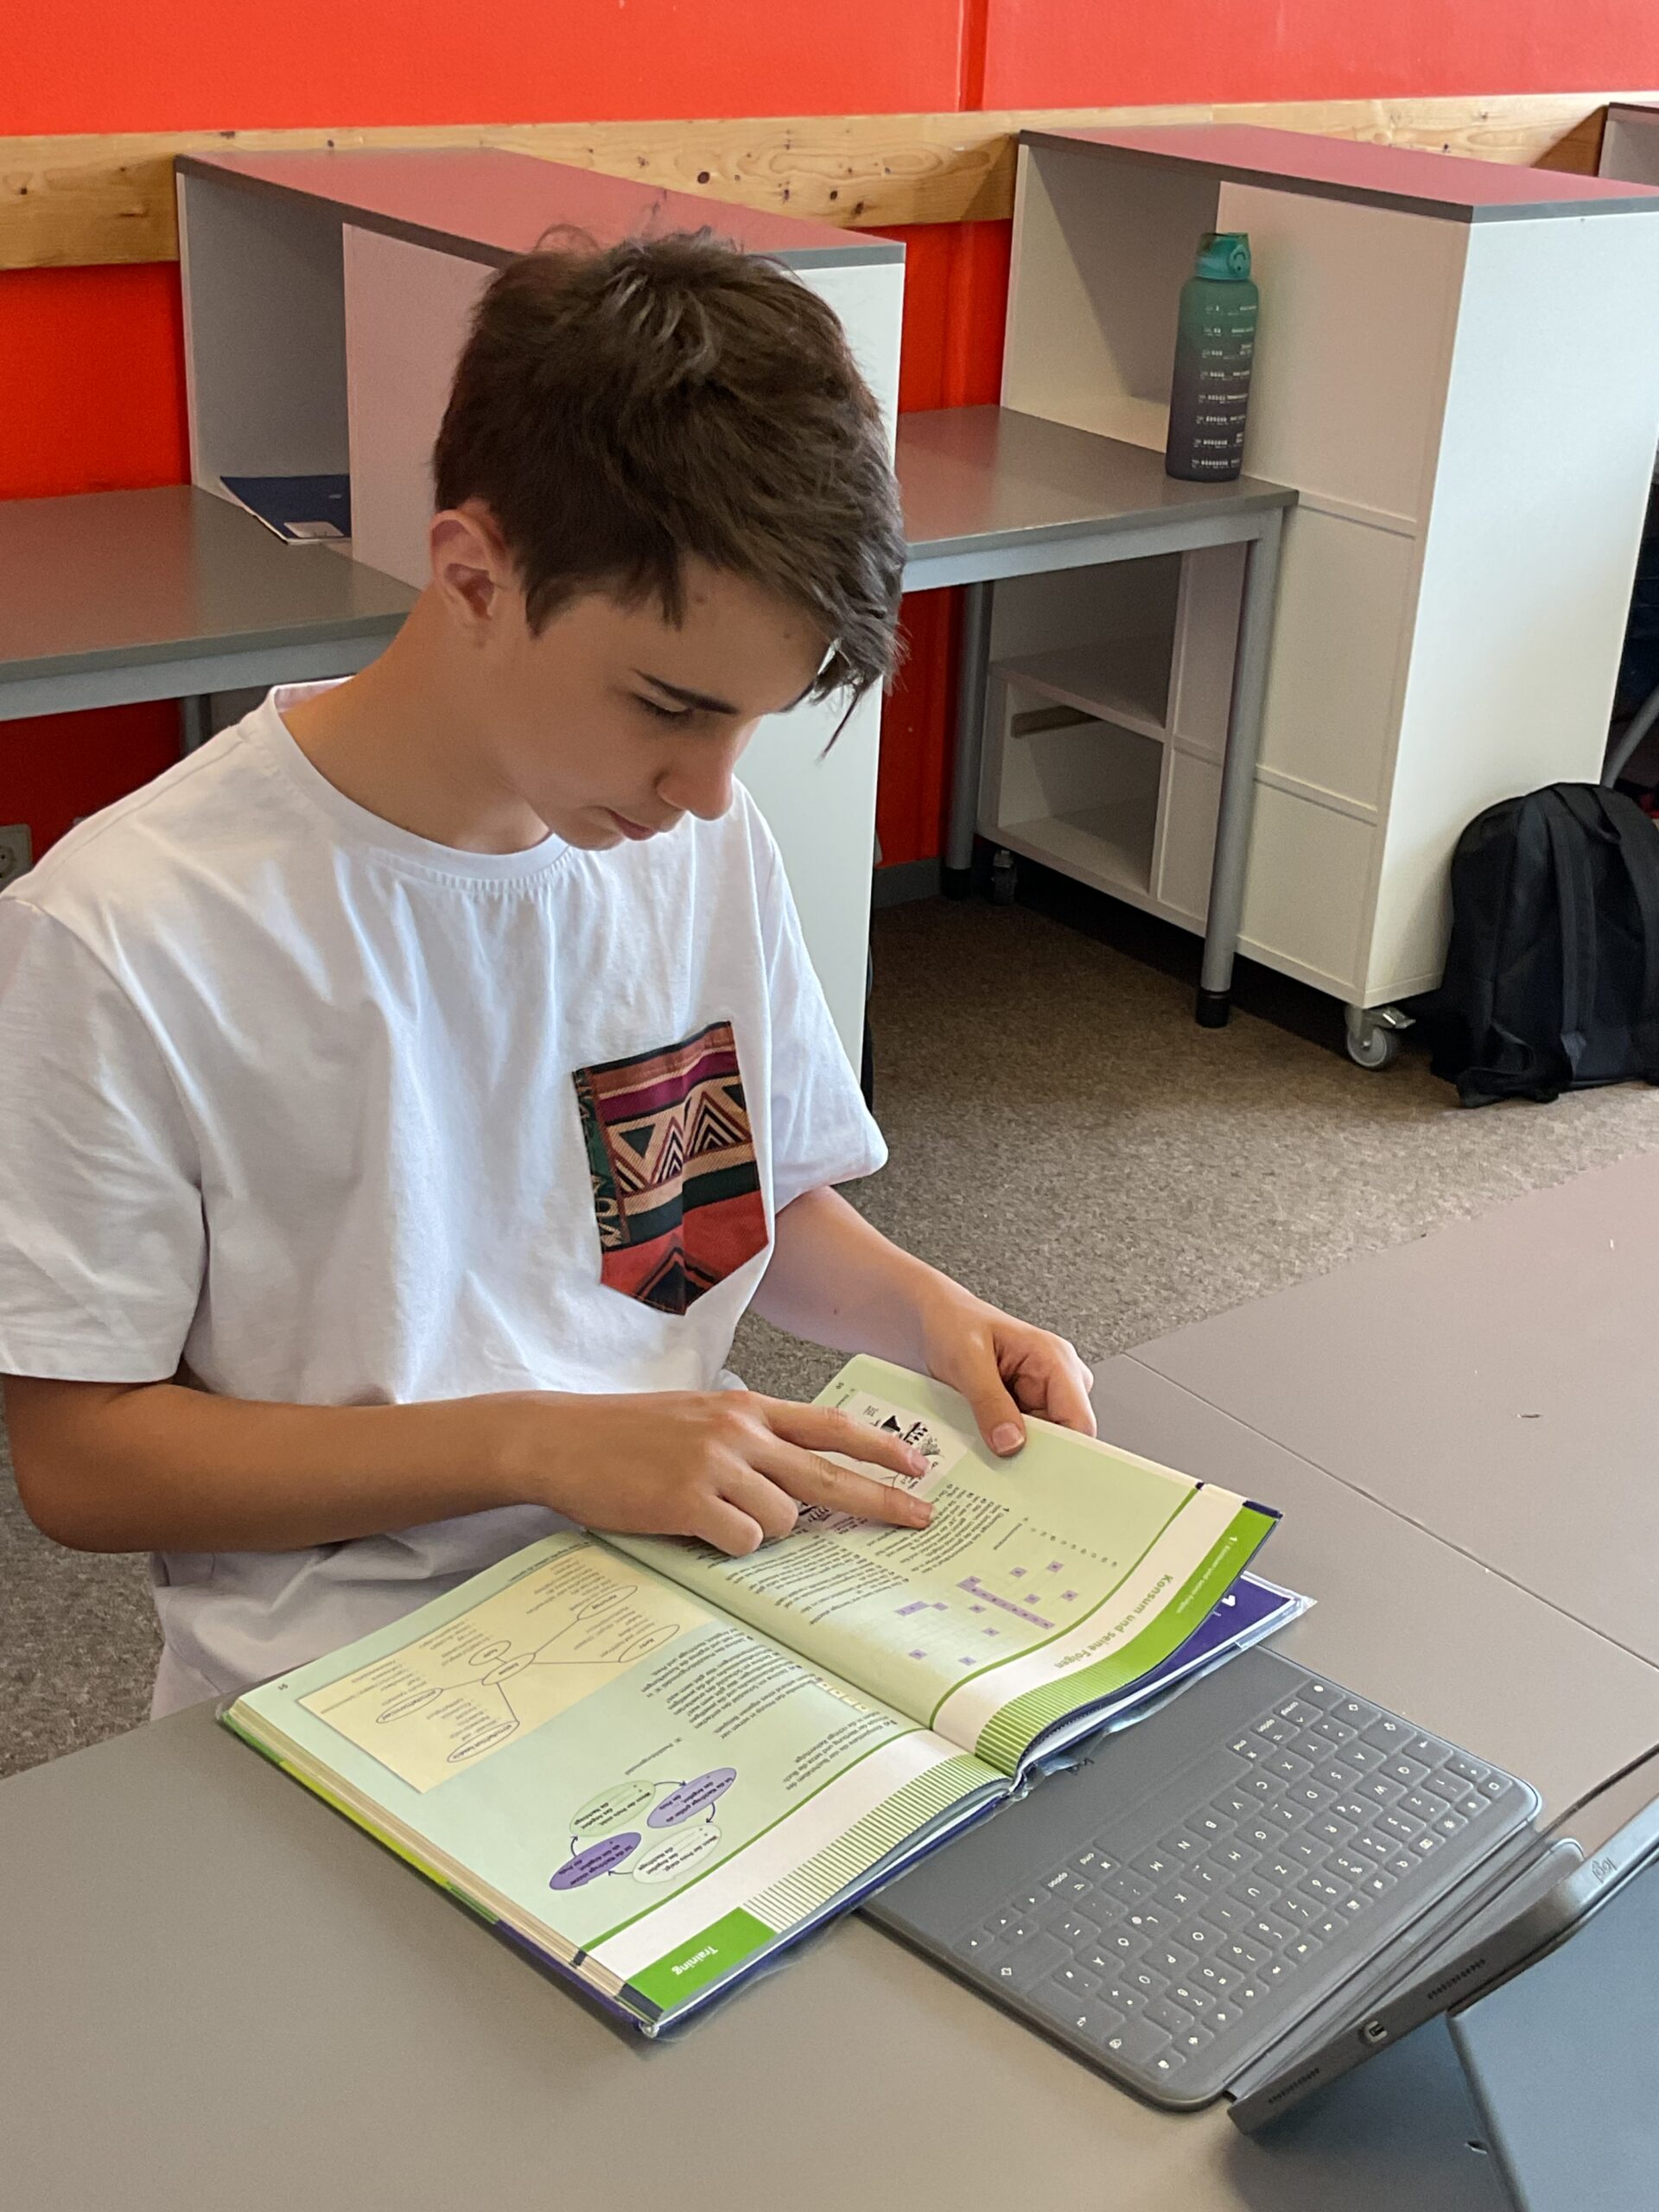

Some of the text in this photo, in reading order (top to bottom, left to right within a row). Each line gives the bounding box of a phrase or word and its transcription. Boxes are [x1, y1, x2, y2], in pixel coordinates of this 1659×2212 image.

[1055, 1573, 1173, 1669] Konsum und seine Folgen
[1047, 1872, 1068, 1888] option
[671, 1945, 719, 1976] Training
